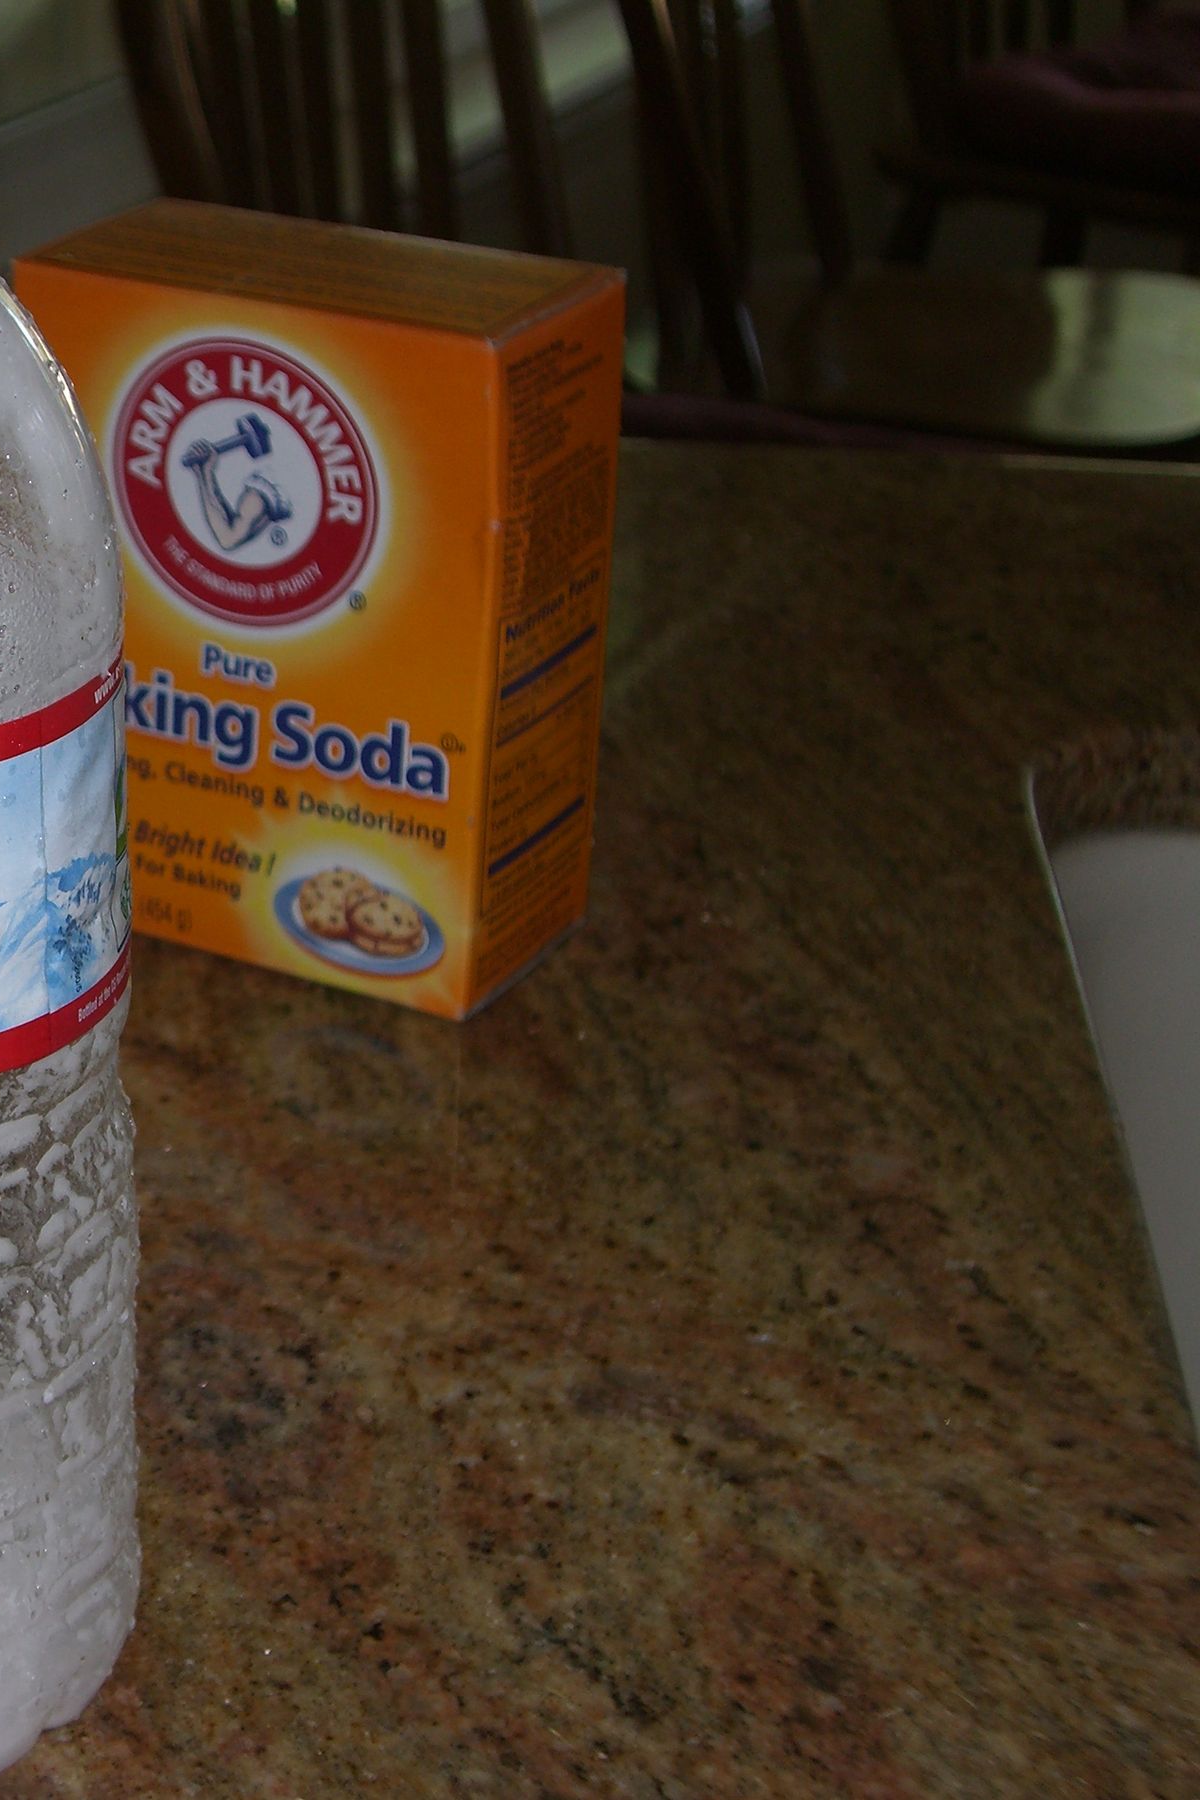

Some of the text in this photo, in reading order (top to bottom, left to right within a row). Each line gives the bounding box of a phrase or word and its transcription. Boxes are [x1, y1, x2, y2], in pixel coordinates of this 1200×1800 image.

[127, 354, 363, 526] ARM & HAMMER
[204, 645, 275, 683] Pure
[125, 664, 256, 767] king
[274, 704, 448, 796] Soda
[165, 760, 265, 808] Cleaning
[273, 787, 290, 809] &
[298, 792, 448, 849] Deodorizing
[134, 820, 206, 857] Bright
[135, 854, 243, 900] For Baking
